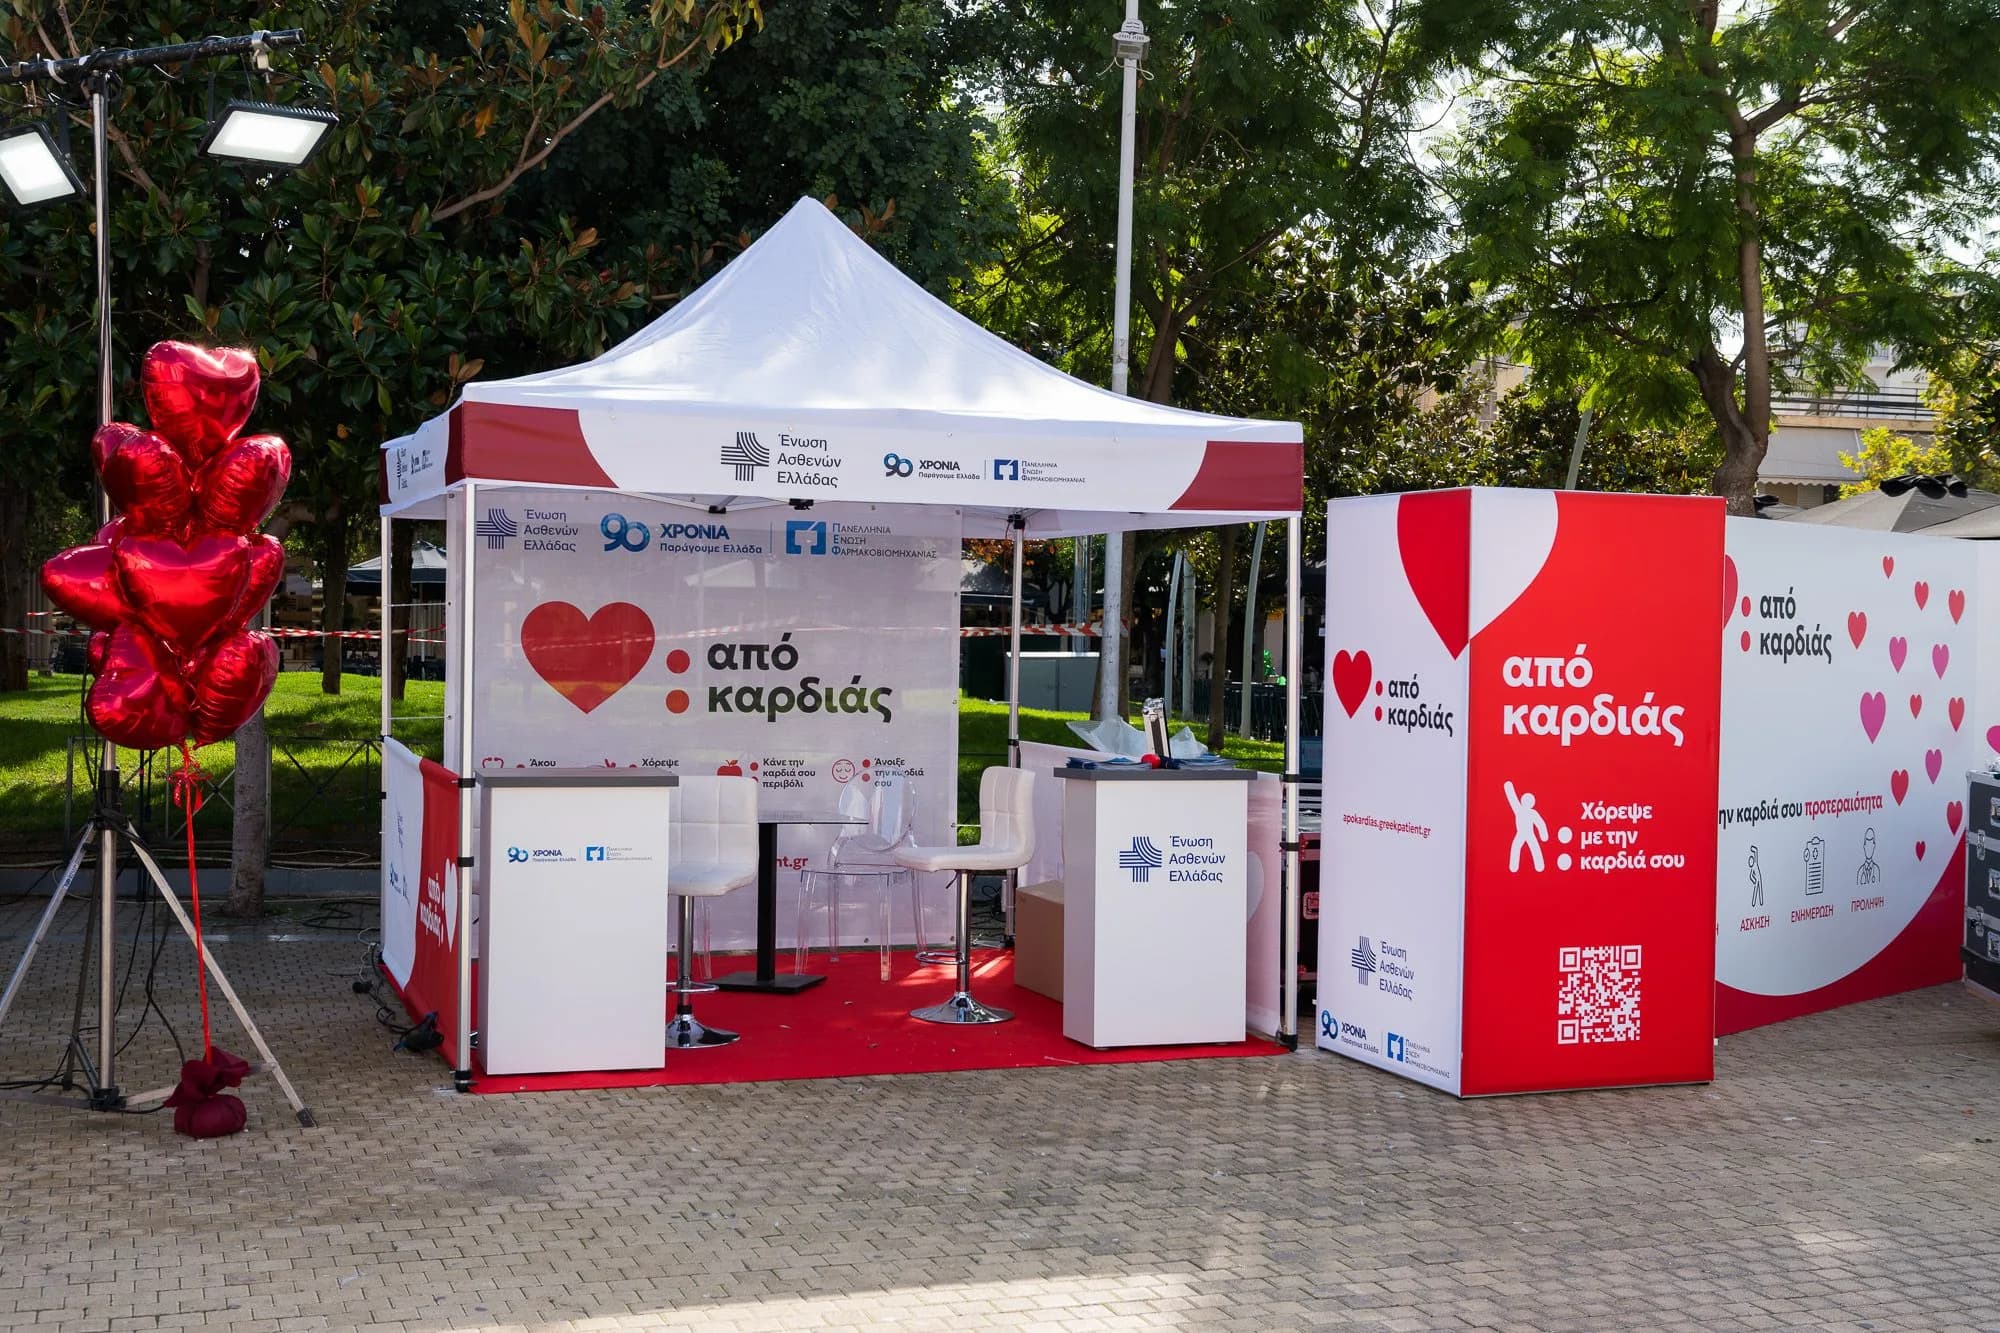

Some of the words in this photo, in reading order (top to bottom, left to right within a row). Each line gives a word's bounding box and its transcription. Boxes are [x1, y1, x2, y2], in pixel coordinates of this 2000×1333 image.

[778, 433, 828, 452] Ένωση
[777, 453, 841, 468] Ασθενών
[884, 453, 913, 478] 90
[919, 460, 960, 471] ΧΡΟΝΙΑ
[777, 471, 839, 488] Ελλάδας
[523, 508, 567, 523] Ένωση
[523, 524, 579, 536] Ασθενών
[600, 512, 651, 553] 90
[660, 523, 729, 540] ΧΡΟΝΙΑ
[832, 523, 891, 534] ΠΑΝΕΛΛΗΝΙΑ
[523, 540, 576, 553] Ελλάδας
[660, 541, 720, 554] Παράγουμε
[723, 542, 762, 554] Ελλάδα
[833, 535, 866, 545] ΕΝΩΣΗ
[831, 546, 937, 559] ΦΑΡΜΑΚΟΒΙΟΜΗΧΑΝΙΑΣ
[1760, 586, 1796, 619] από
[707, 632, 799, 671] από
[1760, 624, 1832, 664] καρδιάς
[1503, 643, 1593, 688] από
[1388, 673, 1419, 699] από
[708, 675, 892, 724] καρδιάς
[1388, 703, 1453, 737] καρδιάς
[1503, 692, 1685, 747] καρδιάς
[529, 758, 557, 767] Άκου
[641, 758, 680, 769] Χόρεψε
[763, 757, 787, 767] Κάνε
[788, 759, 805, 769] την
[874, 757, 905, 768] Άνοιξε
[763, 768, 796, 779] καρδιά
[874, 770, 890, 779] την
[762, 778, 804, 790] περιβόλι
[1580, 801, 1653, 824] Χόρεψε
[1719, 808, 1734, 830] ην
[1737, 798, 1779, 827] καρδιά
[1781, 805, 1803, 819] σου
[1805, 791, 1883, 820] προτεραιότητα
[1343, 813, 1431, 839] apokardias.greekpatient.gr
[1169, 835, 1213, 849] Ένωση
[1580, 830, 1603, 849] με
[1606, 829, 1638, 848] την
[533, 849, 563, 857] ΧΡΟΝΙΑ
[1169, 852, 1226, 865] Ασθενών
[1580, 850, 1647, 874] καρδιά
[1650, 853, 1685, 869] σου
[1169, 870, 1223, 884] Ελλάδας
[1740, 915, 1770, 931] ΑΣΚΗΣΗ
[1791, 904, 1834, 923] ΕΝΗΜΕΡΩΣΗ
[1851, 896, 1885, 912] ΠΡΟΛΗΨΗ
[1381, 940, 1407, 961] Ένωση
[1379, 960, 1415, 980] Ασθενών
[1379, 978, 1413, 1000] Ελλάδας
[1341, 1022, 1367, 1040] ΧΡΟΝΙΑ
